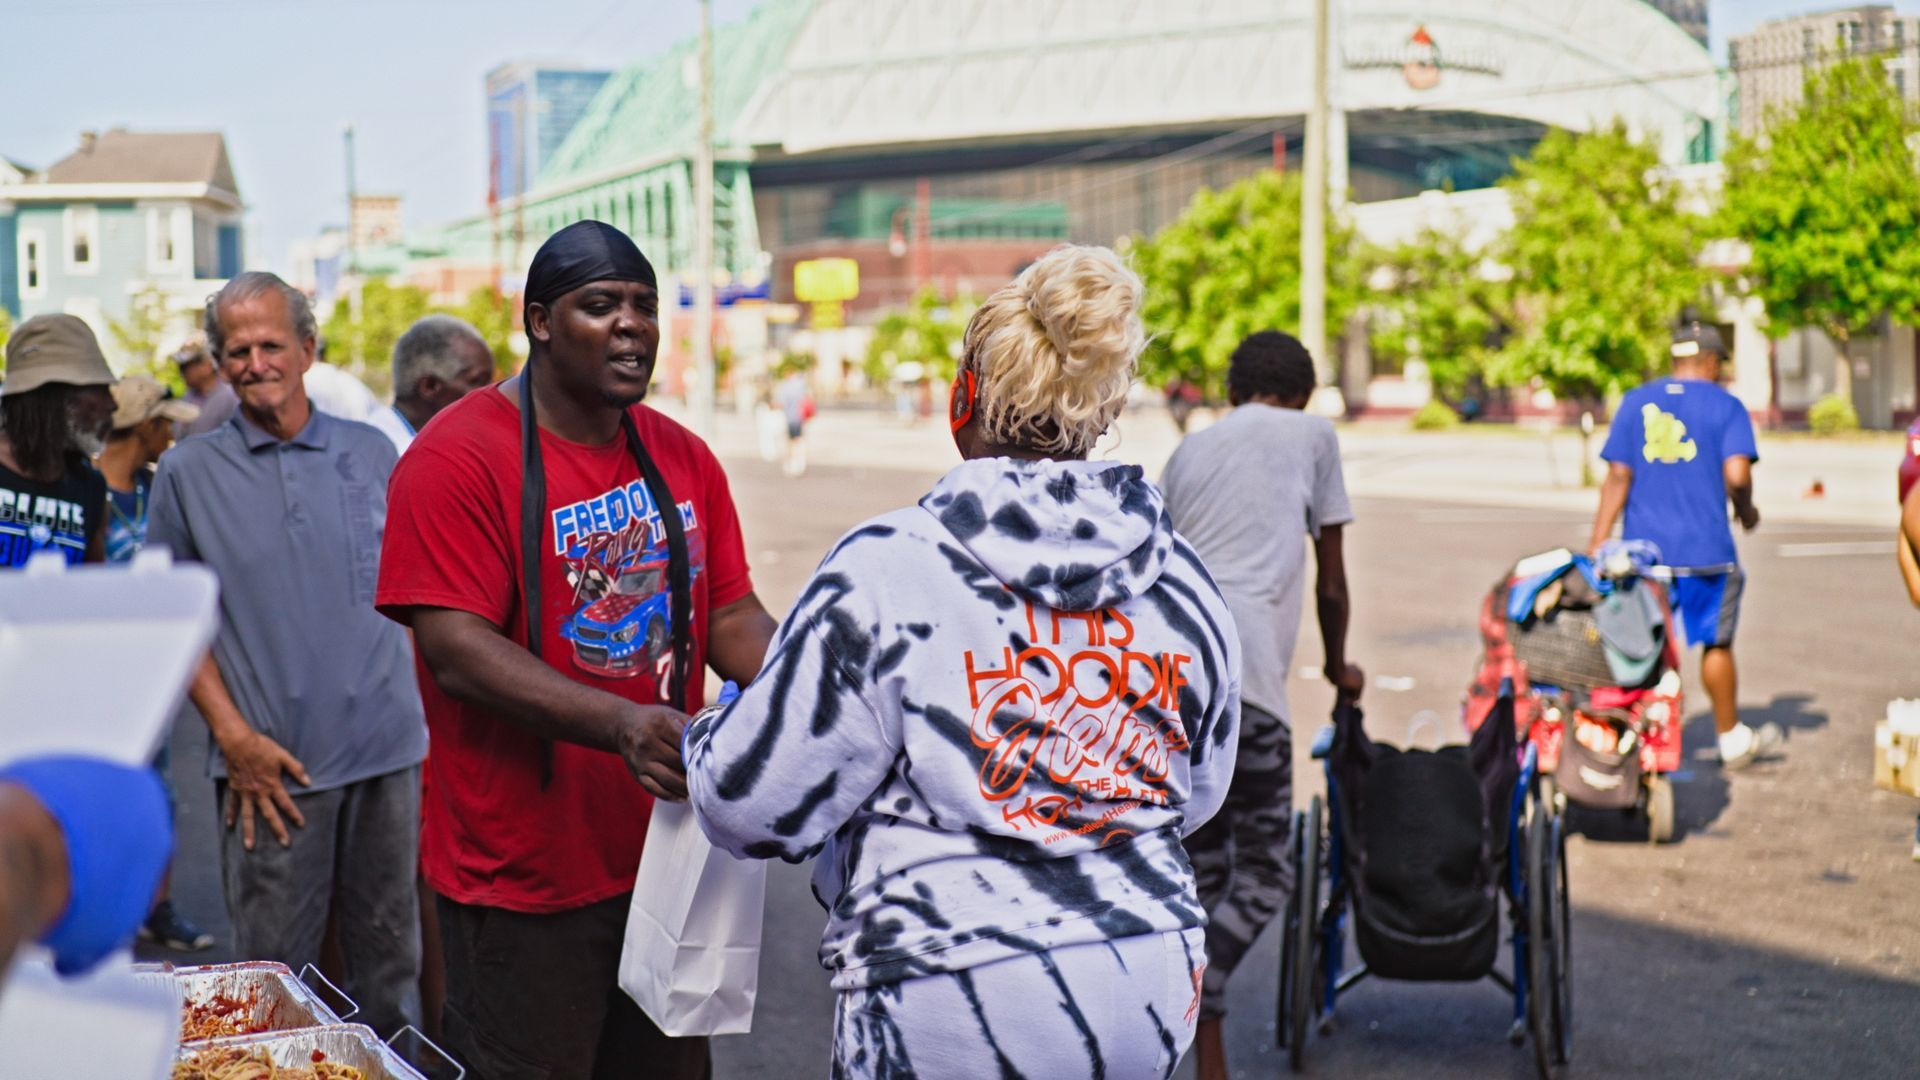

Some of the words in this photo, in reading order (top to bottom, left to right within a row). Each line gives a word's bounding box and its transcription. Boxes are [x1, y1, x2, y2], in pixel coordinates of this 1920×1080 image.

[1024, 600, 1134, 647] THIS
[964, 646, 1191, 711] HOODIE
[1073, 777, 1112, 793] THE
